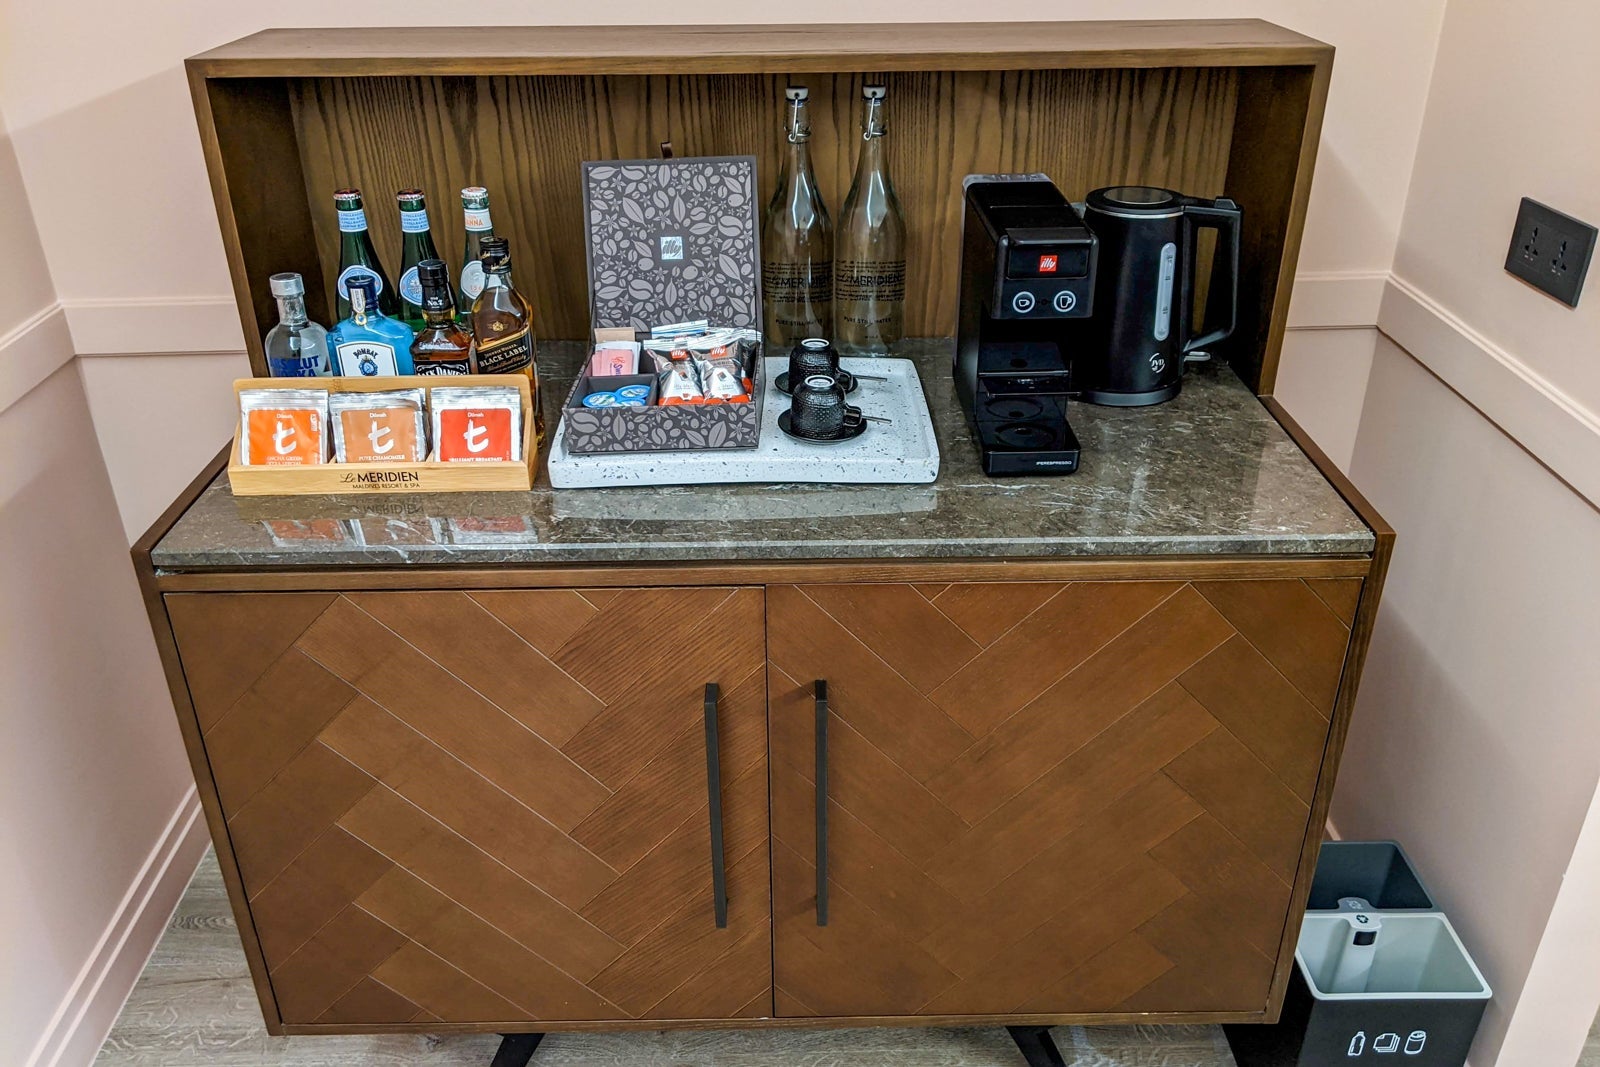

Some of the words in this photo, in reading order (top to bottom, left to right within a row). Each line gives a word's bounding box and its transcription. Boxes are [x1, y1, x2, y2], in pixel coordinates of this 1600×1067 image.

[662, 240, 682, 257] illy
[1040, 257, 1056, 270] illy
[353, 348, 379, 359] BOMBAY
[479, 353, 505, 368] BLACK
[504, 344, 528, 359] LABEL
[711, 347, 726, 355] illy
[340, 473, 356, 483] Le
[358, 472, 419, 483] MERIDIEN
